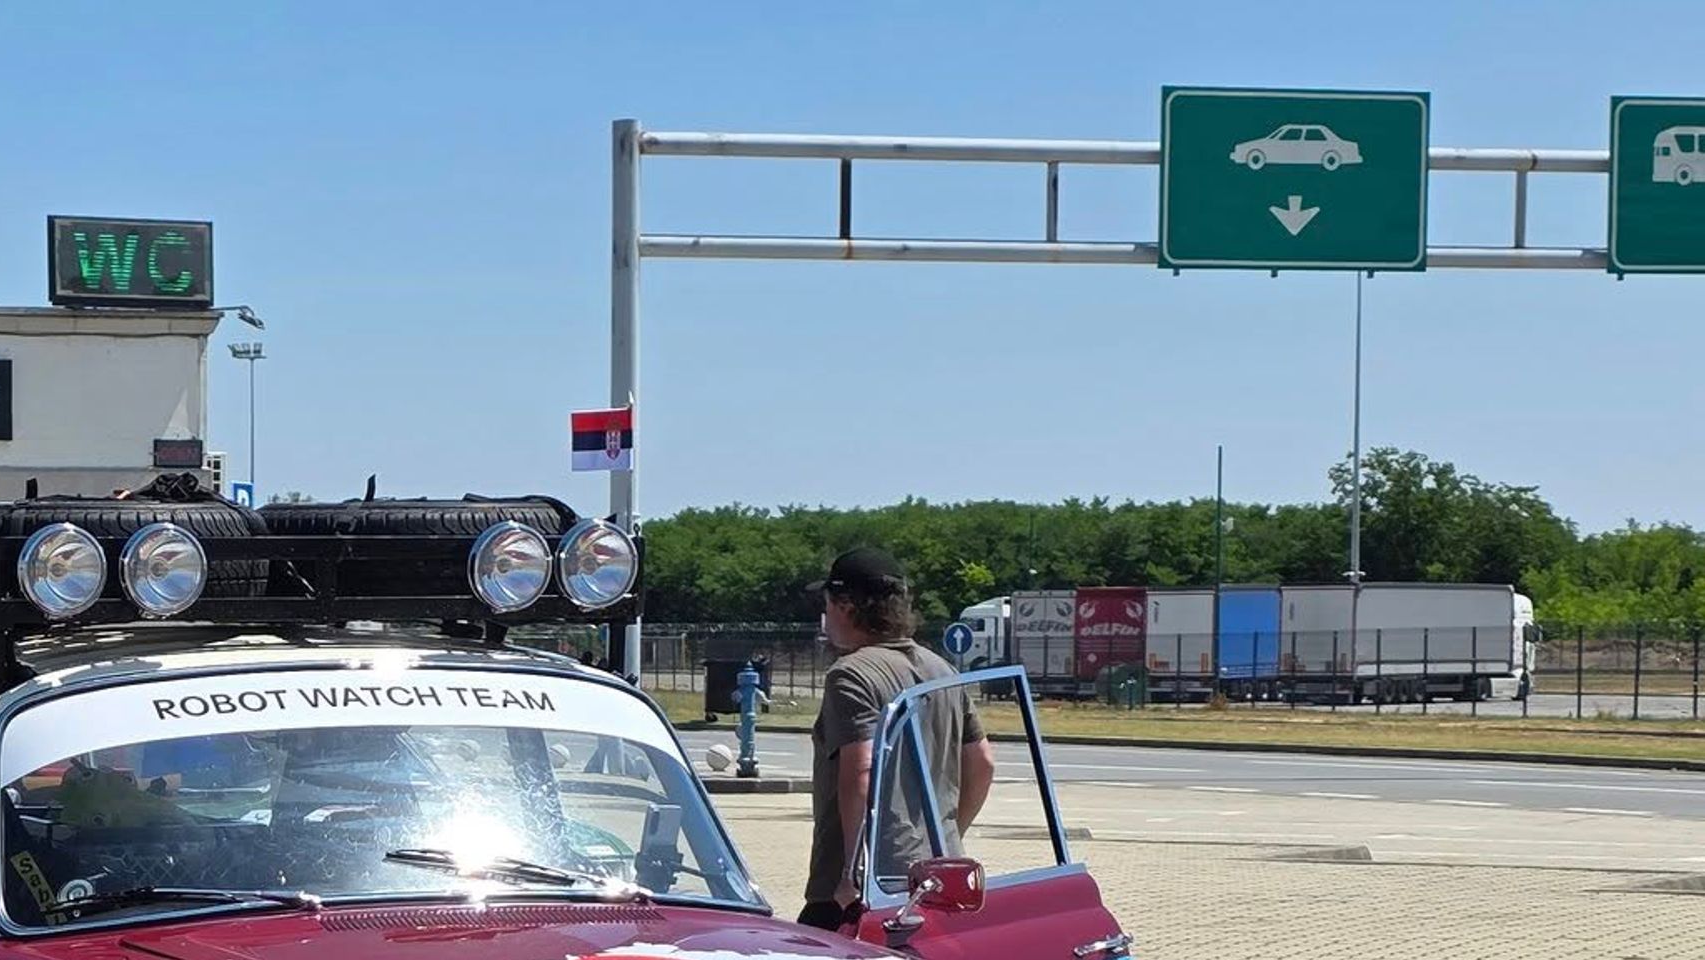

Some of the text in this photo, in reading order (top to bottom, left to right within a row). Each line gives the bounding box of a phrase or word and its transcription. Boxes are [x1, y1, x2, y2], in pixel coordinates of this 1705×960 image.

[73, 232, 193, 293] WC
[152, 685, 557, 721] ROBOT WATCH TEAM
